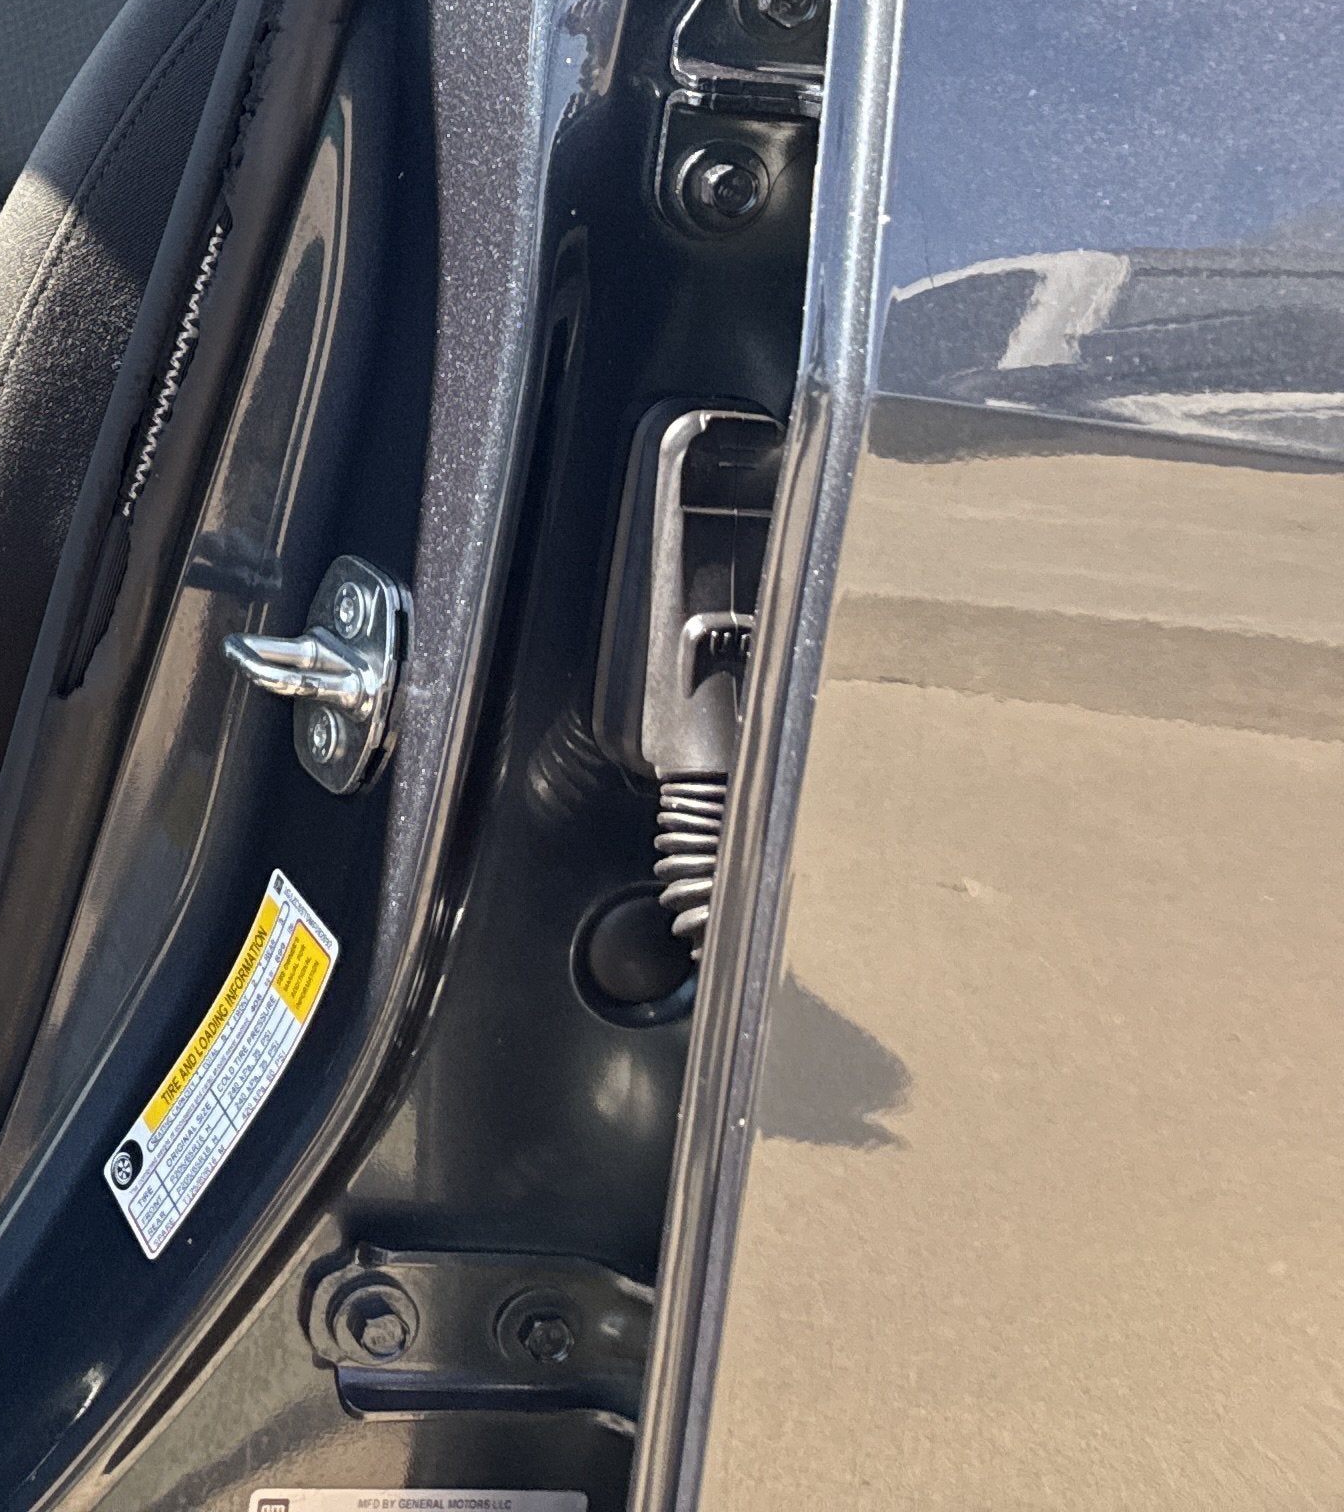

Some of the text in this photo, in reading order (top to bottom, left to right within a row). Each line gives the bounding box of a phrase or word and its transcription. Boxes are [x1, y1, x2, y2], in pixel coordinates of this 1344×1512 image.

[160, 924, 268, 1105] TIRE AND LOADING INFORMATION
[260, 1028, 271, 1046] PSI
[267, 1039, 279, 1058] PSI
[136, 993, 276, 1207] TIRE ORIGINAL SIZE COLD TIRE PRESSURE
[382, 1499, 396, 1509] BY
[398, 1499, 444, 1510] GENERAL
[447, 1499, 490, 1510] MOTORS
